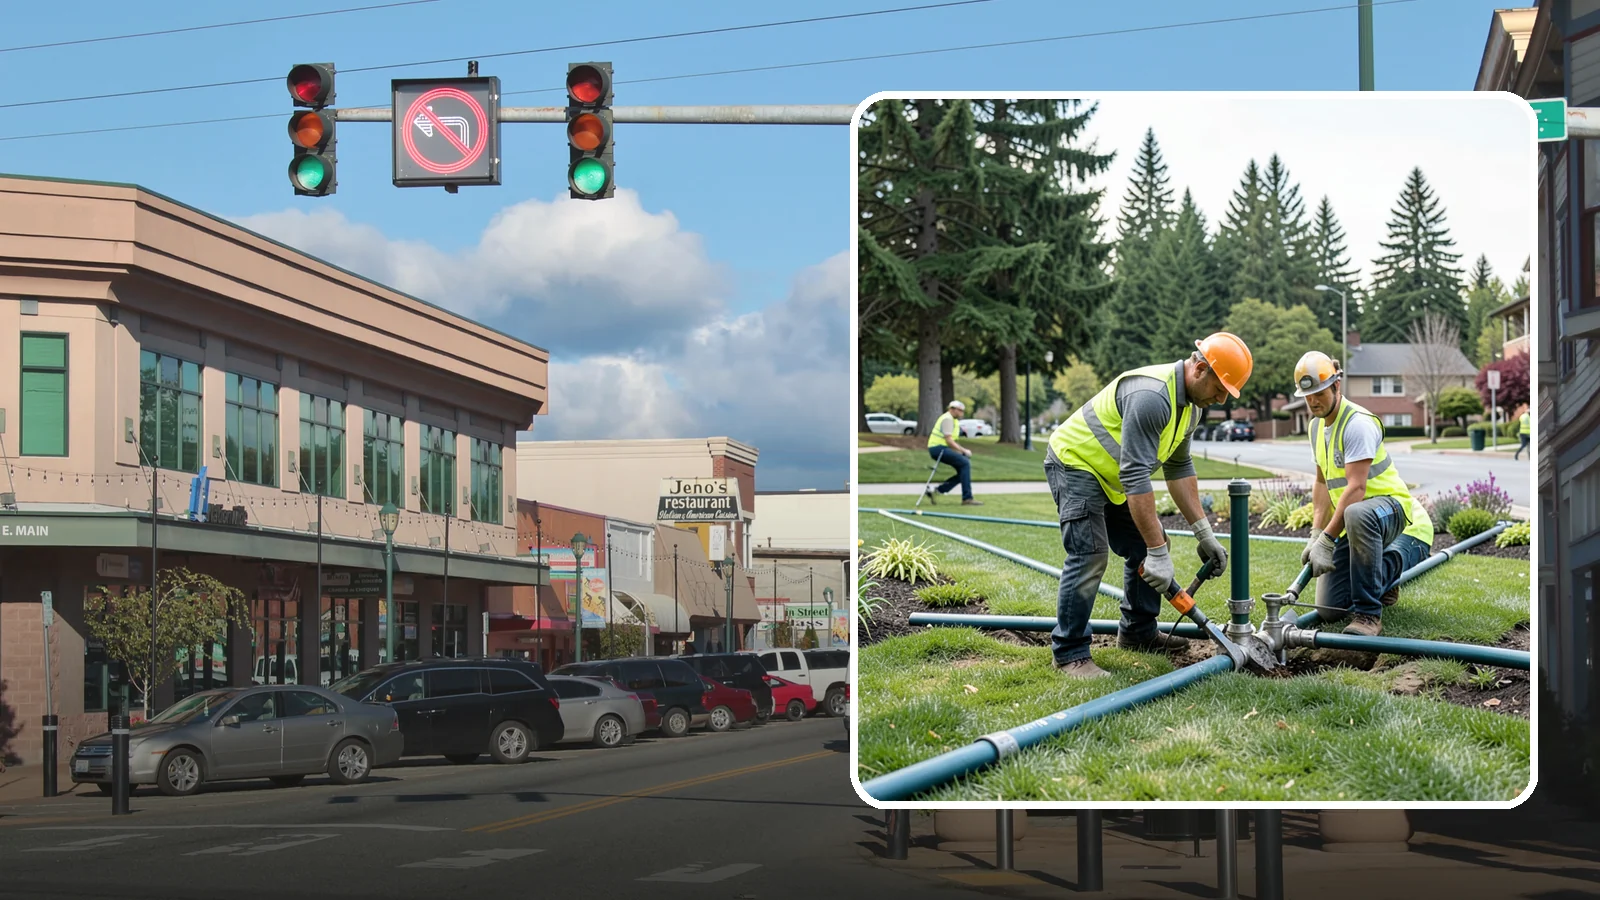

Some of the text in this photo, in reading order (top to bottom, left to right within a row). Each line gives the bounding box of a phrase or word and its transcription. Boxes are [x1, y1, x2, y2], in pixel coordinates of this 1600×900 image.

[669, 480, 727, 494] Jeno's
[665, 496, 731, 509] restaurant
[658, 510, 681, 519] Italian
[685, 510, 714, 519] American
[715, 509, 737, 519] Cuisine
[2, 525, 49, 536] E. MAIN
[797, 608, 828, 616] Street
